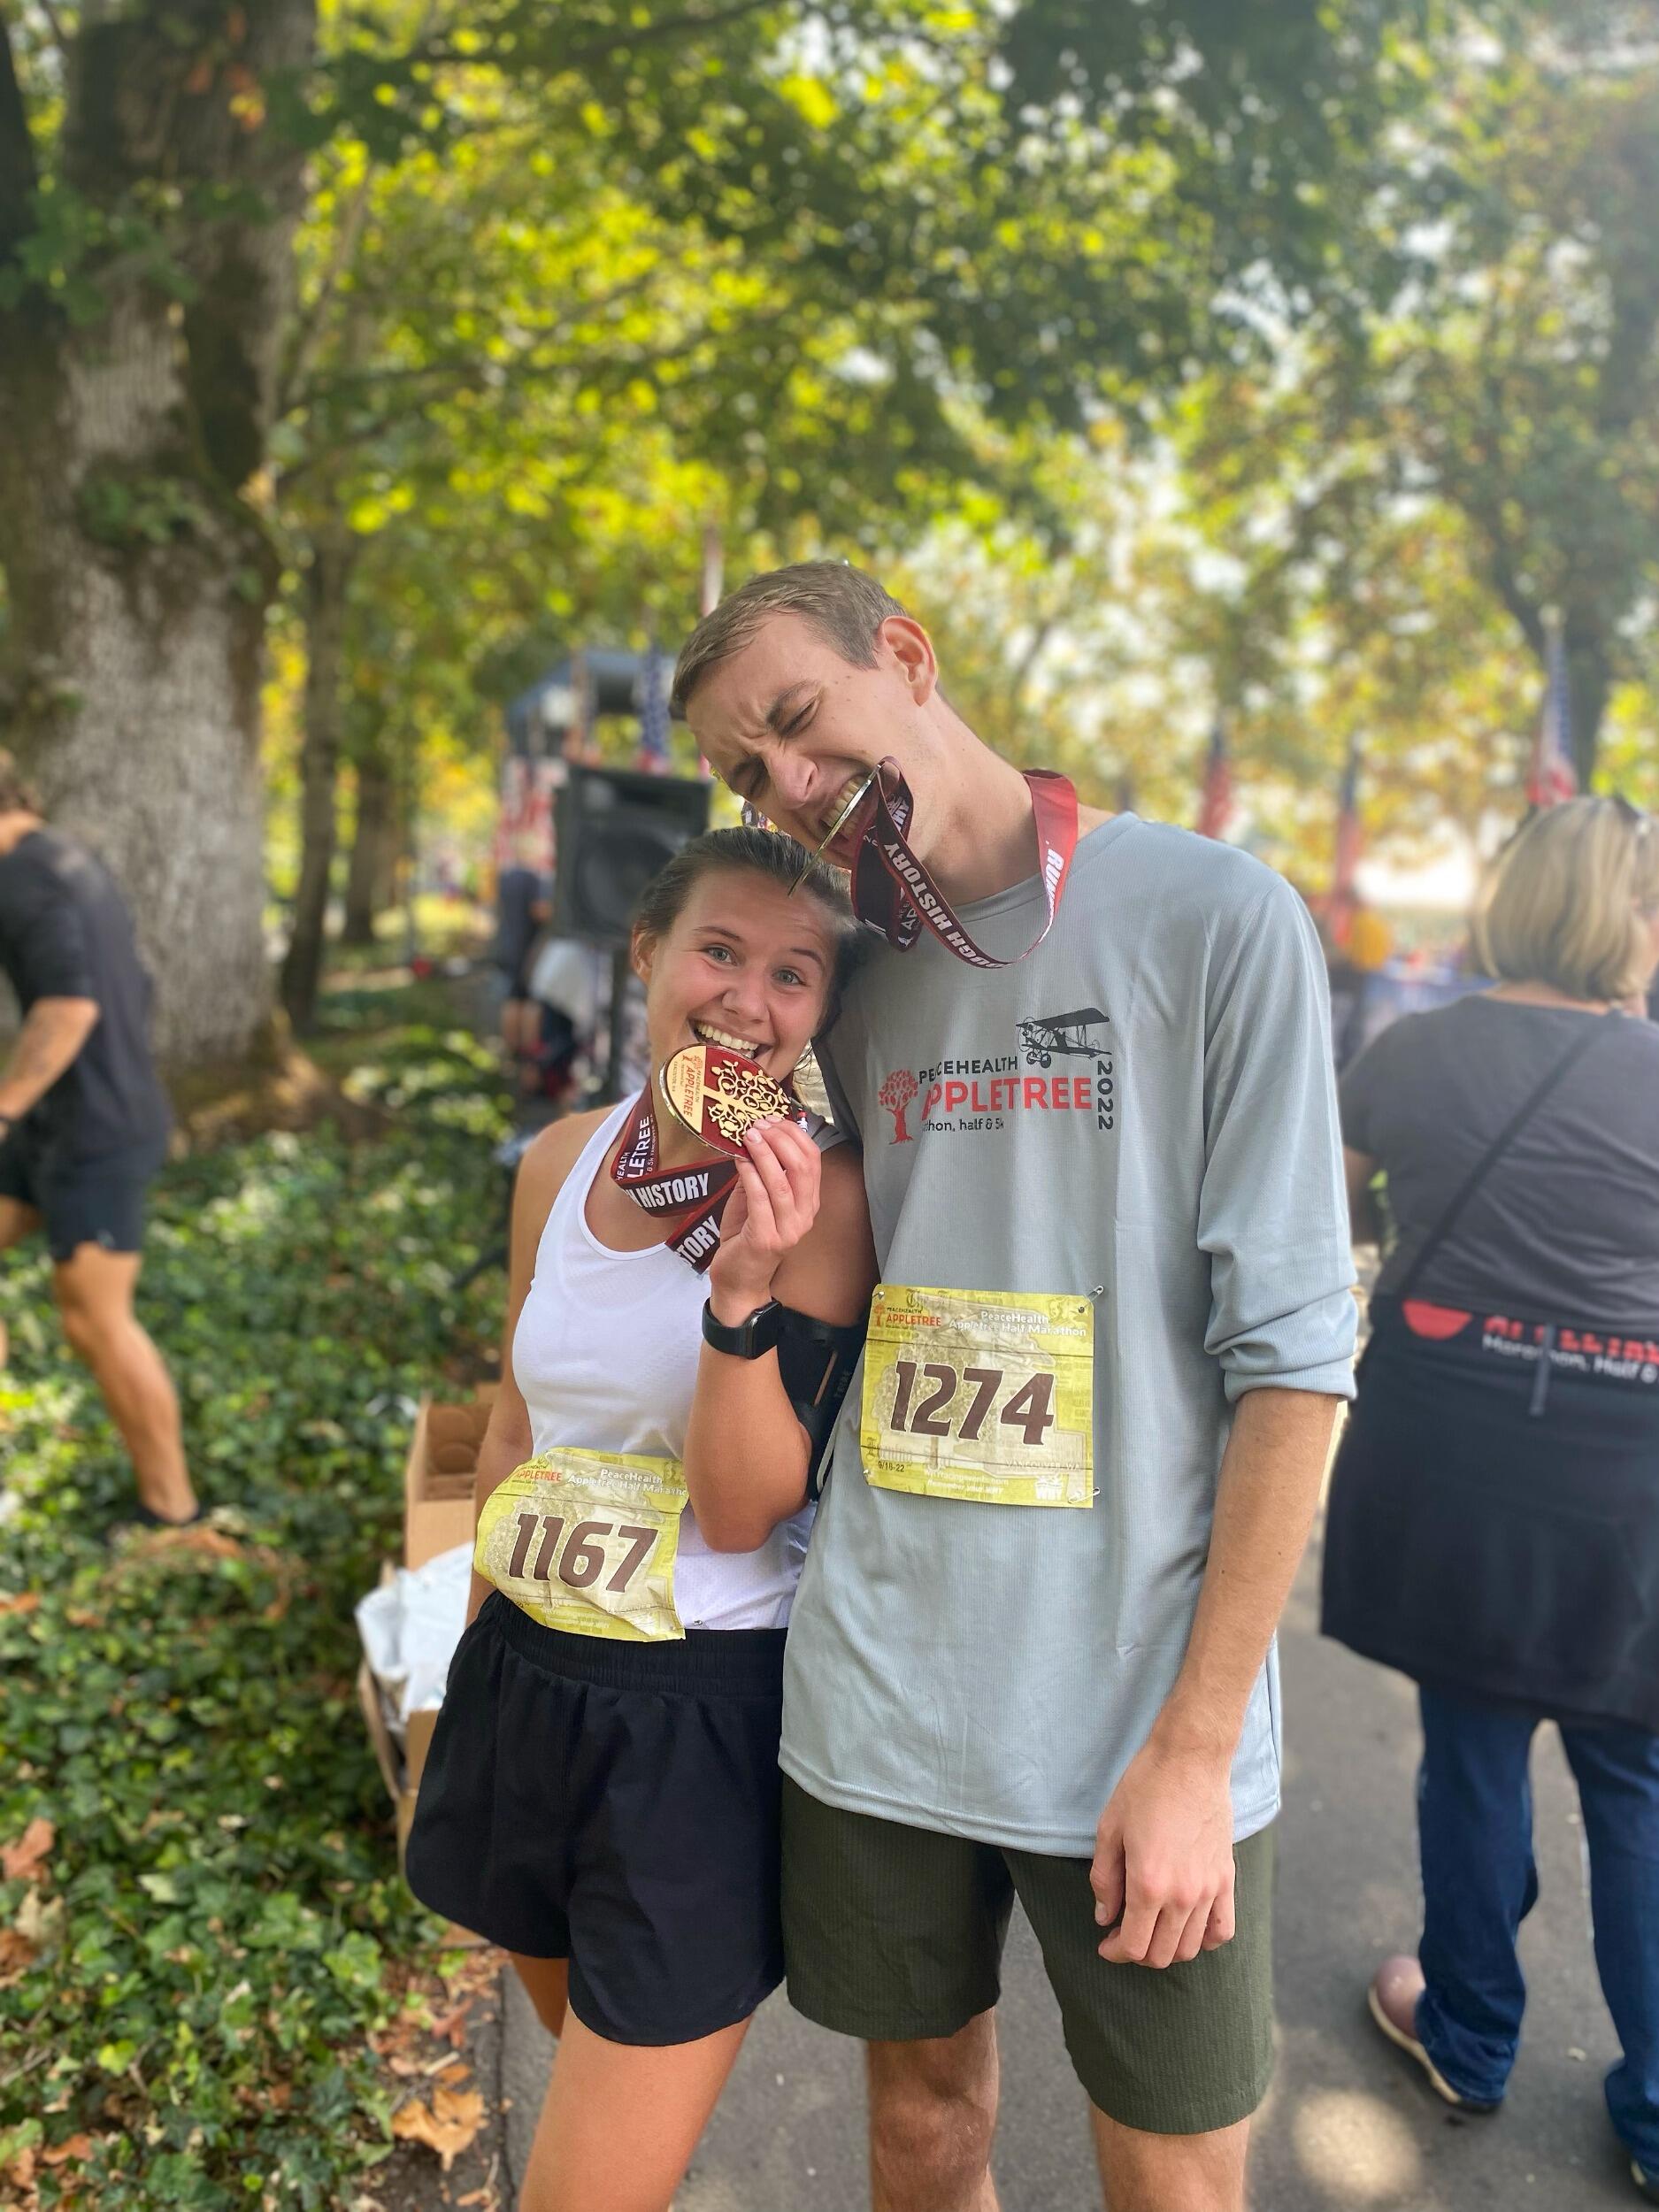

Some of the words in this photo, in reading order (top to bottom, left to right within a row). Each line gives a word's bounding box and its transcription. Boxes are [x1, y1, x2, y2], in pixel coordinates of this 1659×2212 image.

[884, 842, 953, 931] HISTORY
[683, 1065, 696, 1117] APPLETREE
[1097, 1060, 1113, 1130] 2022
[959, 1118, 983, 1130] half
[635, 1172, 709, 1209] HISTORY
[887, 1313, 942, 1327] APPLETREE
[981, 1310, 1048, 1325] PeaceHealth
[1002, 1322, 1025, 1334] Half
[1028, 1325, 1087, 1337] Marathon
[890, 1361, 1055, 1446] 1274
[517, 1469, 563, 1482] APPLETREE
[601, 1469, 663, 1484] PeaceHealth
[509, 1513, 658, 1594] 1167
